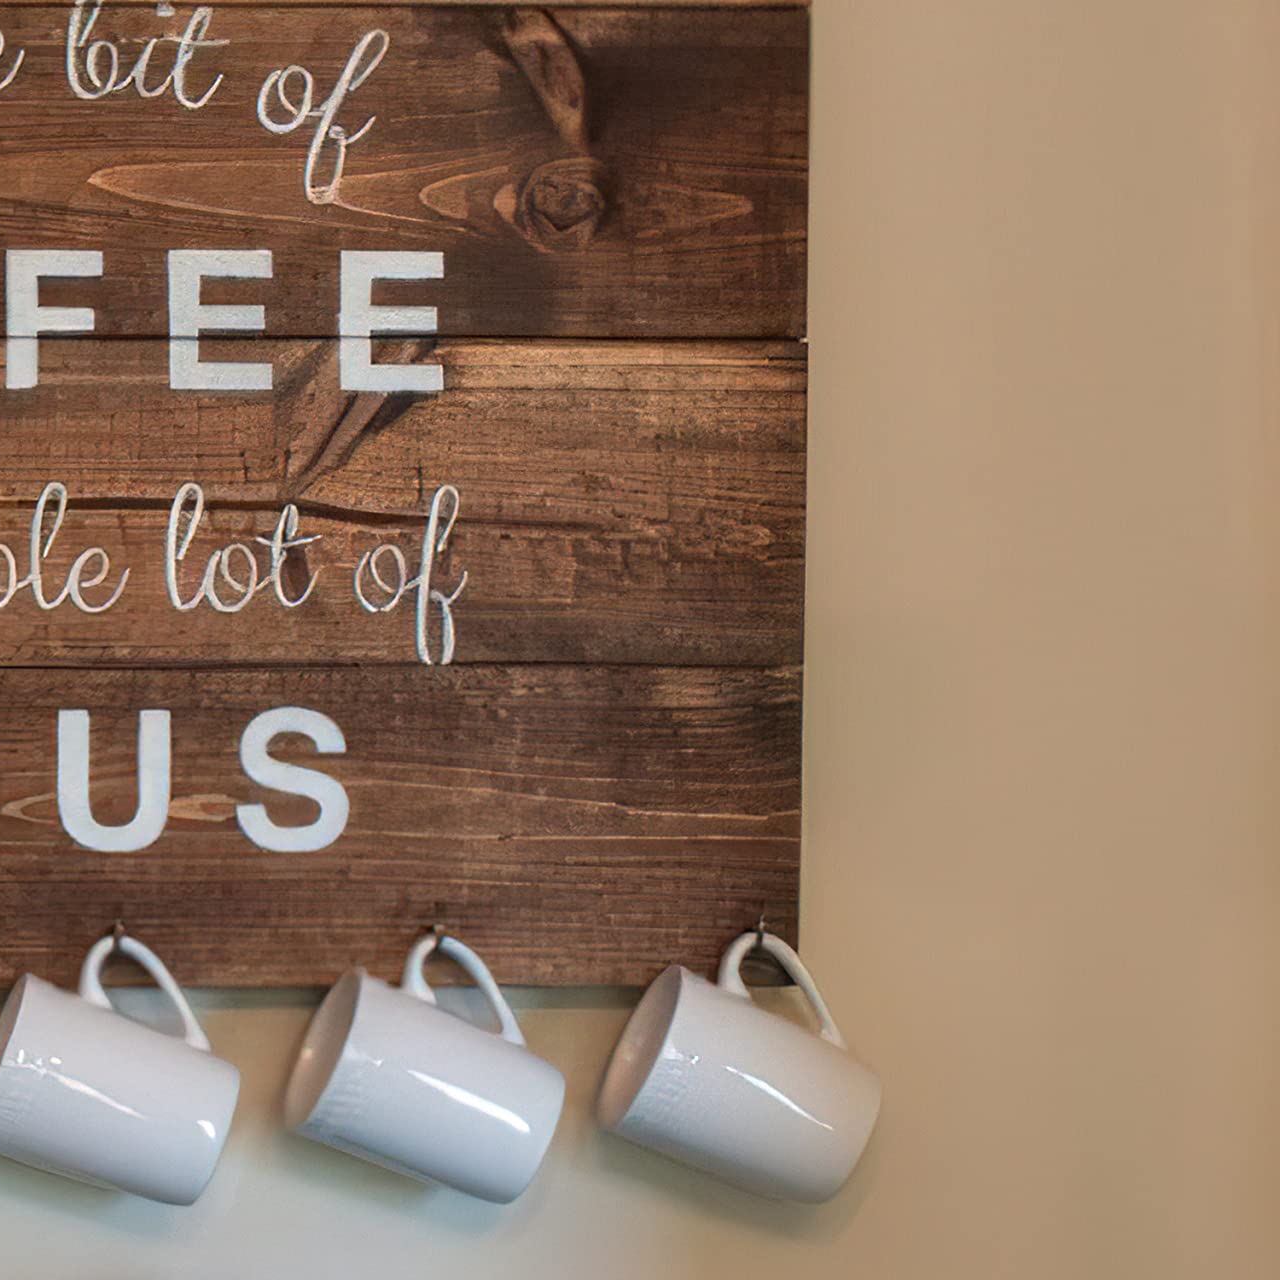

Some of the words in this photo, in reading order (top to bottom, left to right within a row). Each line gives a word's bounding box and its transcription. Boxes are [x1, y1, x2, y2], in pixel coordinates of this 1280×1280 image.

[66, 0, 231, 110] bit
[256, 28, 390, 204] of
[166, 482, 323, 614] lot
[351, 483, 469, 667] of
